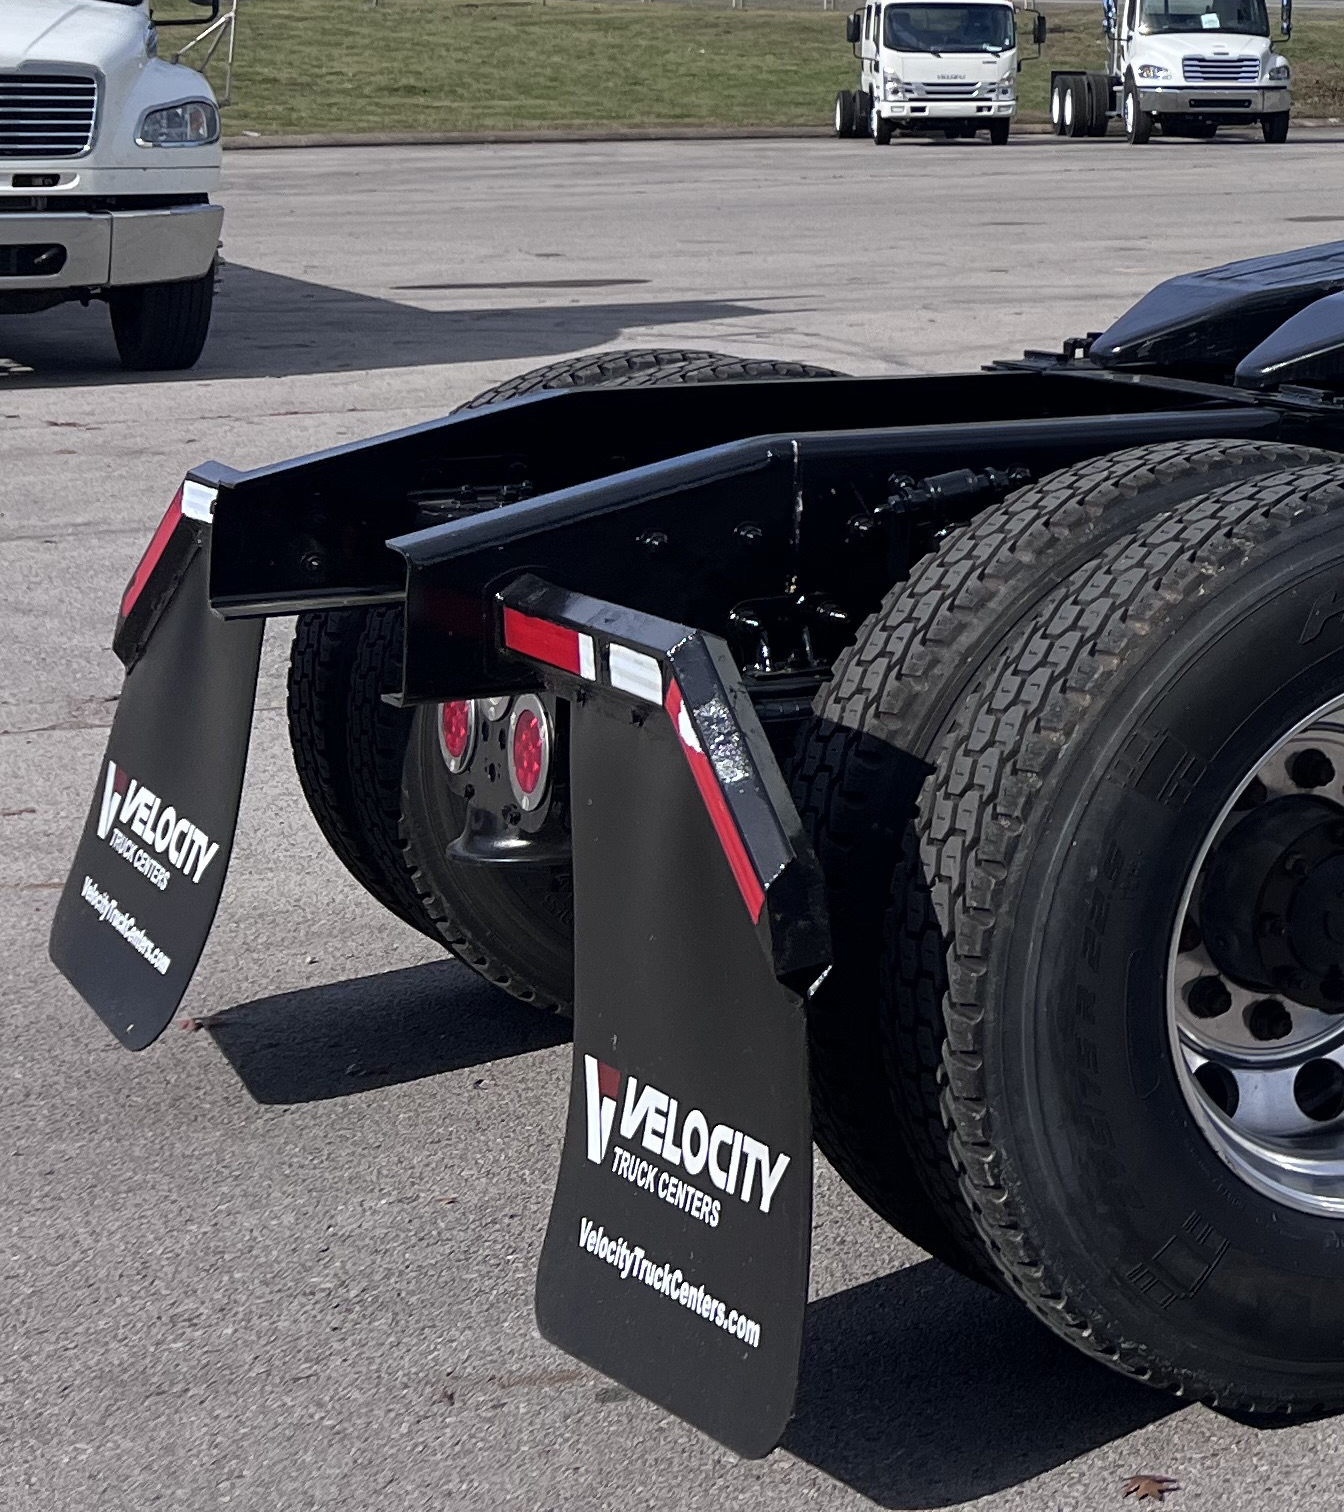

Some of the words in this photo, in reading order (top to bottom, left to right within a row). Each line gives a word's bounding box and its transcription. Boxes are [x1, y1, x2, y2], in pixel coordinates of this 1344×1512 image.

[109, 828, 138, 863] TRUCK
[133, 849, 170, 891] CENTERS
[119, 779, 220, 884] VELOCITY
[81, 875, 171, 975] VelocityTruckCenters.com
[611, 1146, 659, 1193] TRUCK
[658, 1172, 721, 1228] CENTERS
[620, 1076, 791, 1213] VELOCITY
[578, 1216, 761, 1348] VelocityTruckCenters.com
